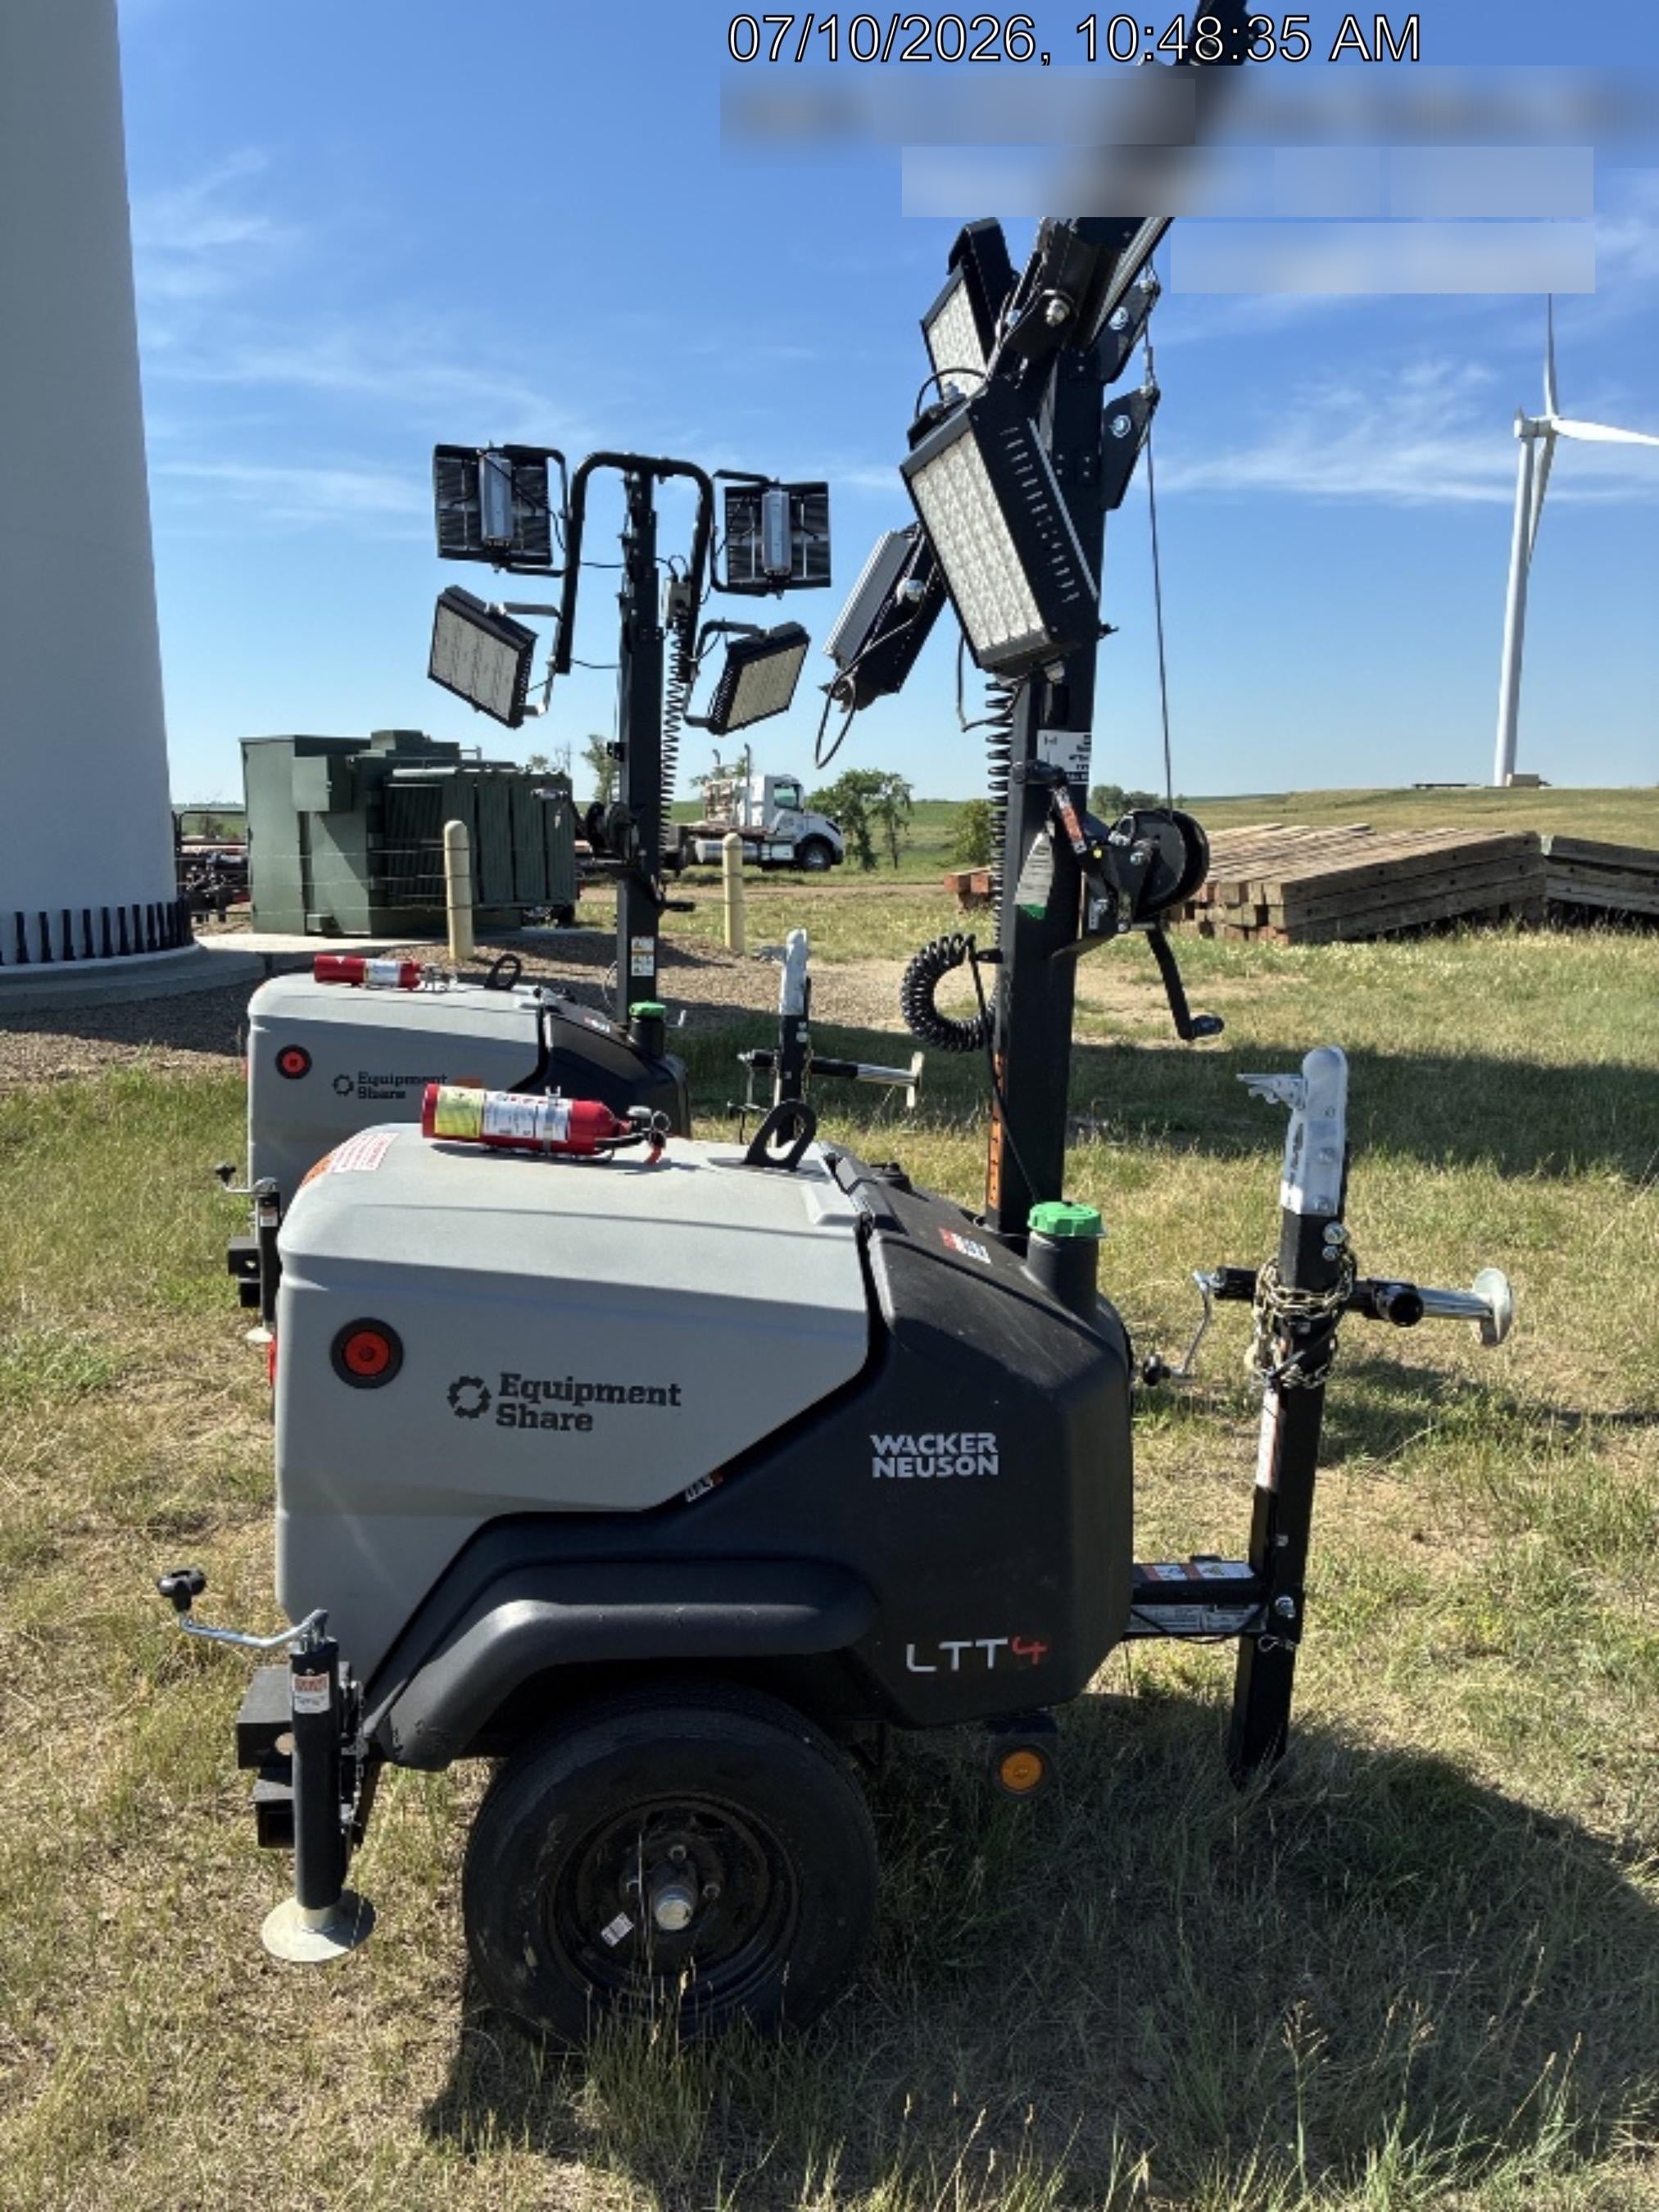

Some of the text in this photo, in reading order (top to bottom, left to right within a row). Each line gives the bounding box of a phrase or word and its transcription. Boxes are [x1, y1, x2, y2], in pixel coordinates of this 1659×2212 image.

[498, 1371, 682, 1407] Equipment
[496, 1403, 593, 1431] Share
[870, 1433, 999, 1456] WACKER
[872, 1456, 999, 1478] NEUSON
